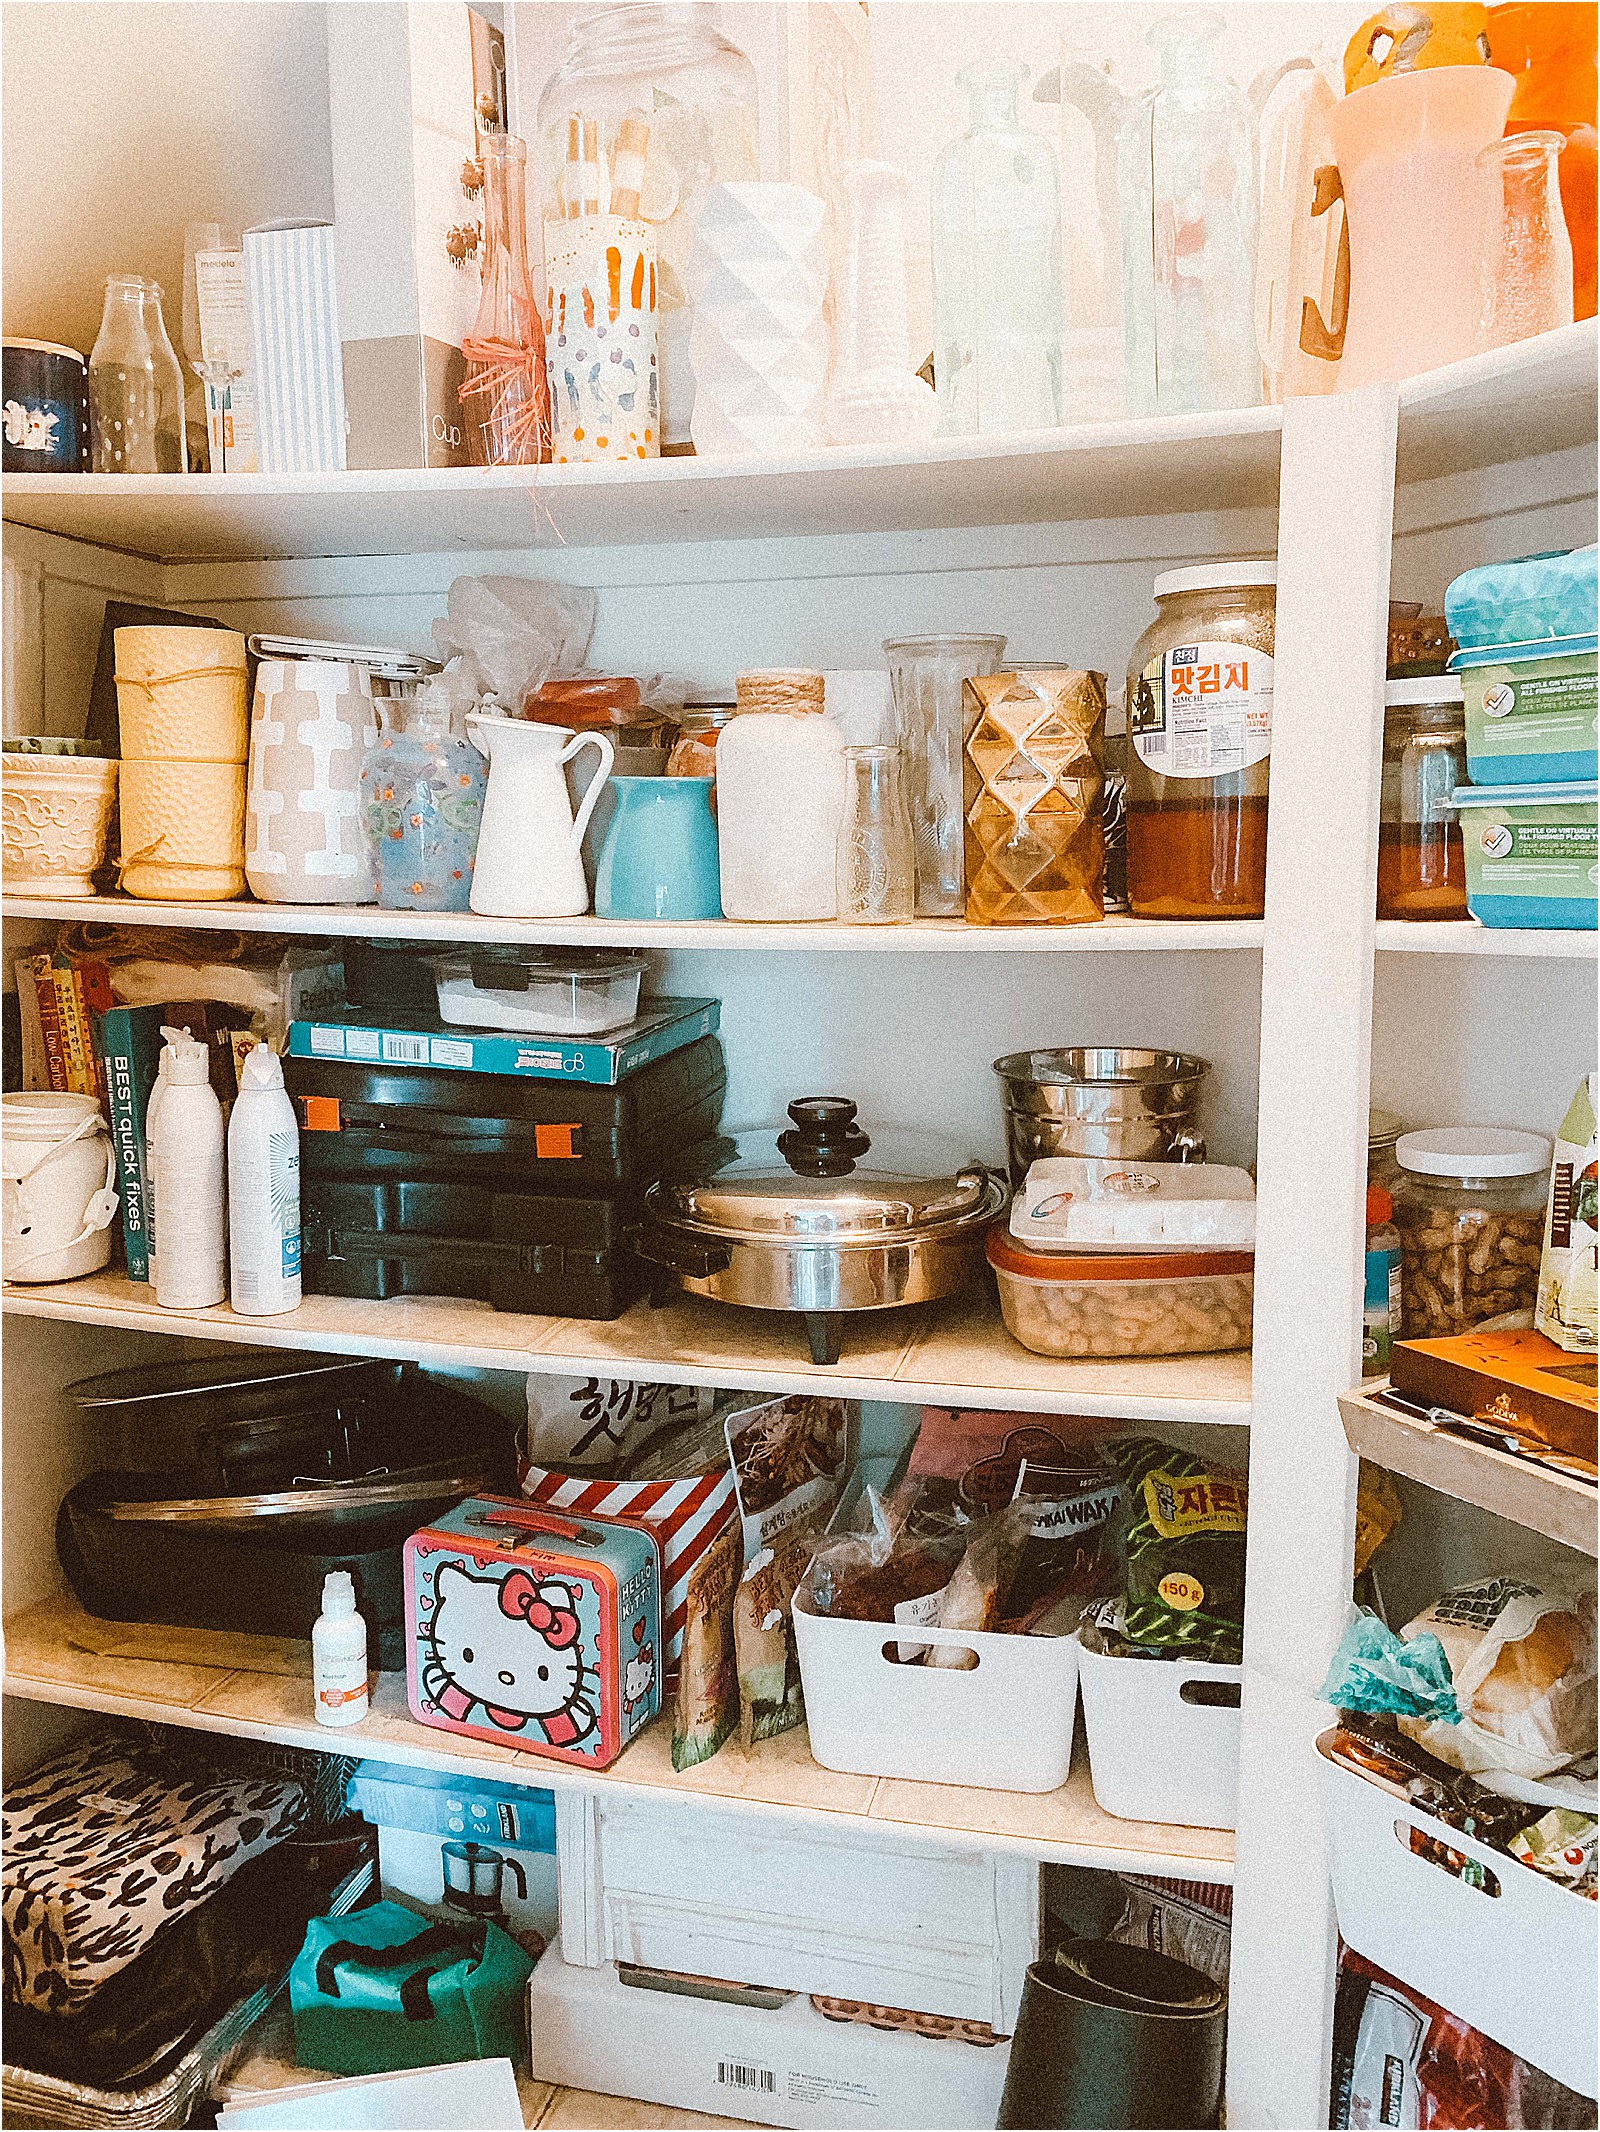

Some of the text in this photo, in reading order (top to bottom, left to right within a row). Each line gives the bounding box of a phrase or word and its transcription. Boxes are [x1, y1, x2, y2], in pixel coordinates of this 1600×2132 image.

[200, 258, 236, 269] medela
[432, 414, 461, 450] Cup
[1171, 661, 1249, 696] 맛김치
[1172, 694, 1203, 704] KIMCHI
[1518, 833, 1532, 841] ALL
[1532, 833, 1565, 841] FINISHED
[1565, 833, 1591, 841] FLOOR
[114, 1056, 141, 1232] BEST quick fixes
[1485, 1403, 1518, 1422] GODIVA
[622, 1564, 652, 1601] HELLO
[1162, 1582, 1200, 1602] 150 g
[622, 1586, 652, 1622] KITTY
[801, 2073, 838, 2085] HOUSEHOLD
[838, 2080, 850, 2088] USE
[1388, 2060, 1403, 2127] KIRKLAND
